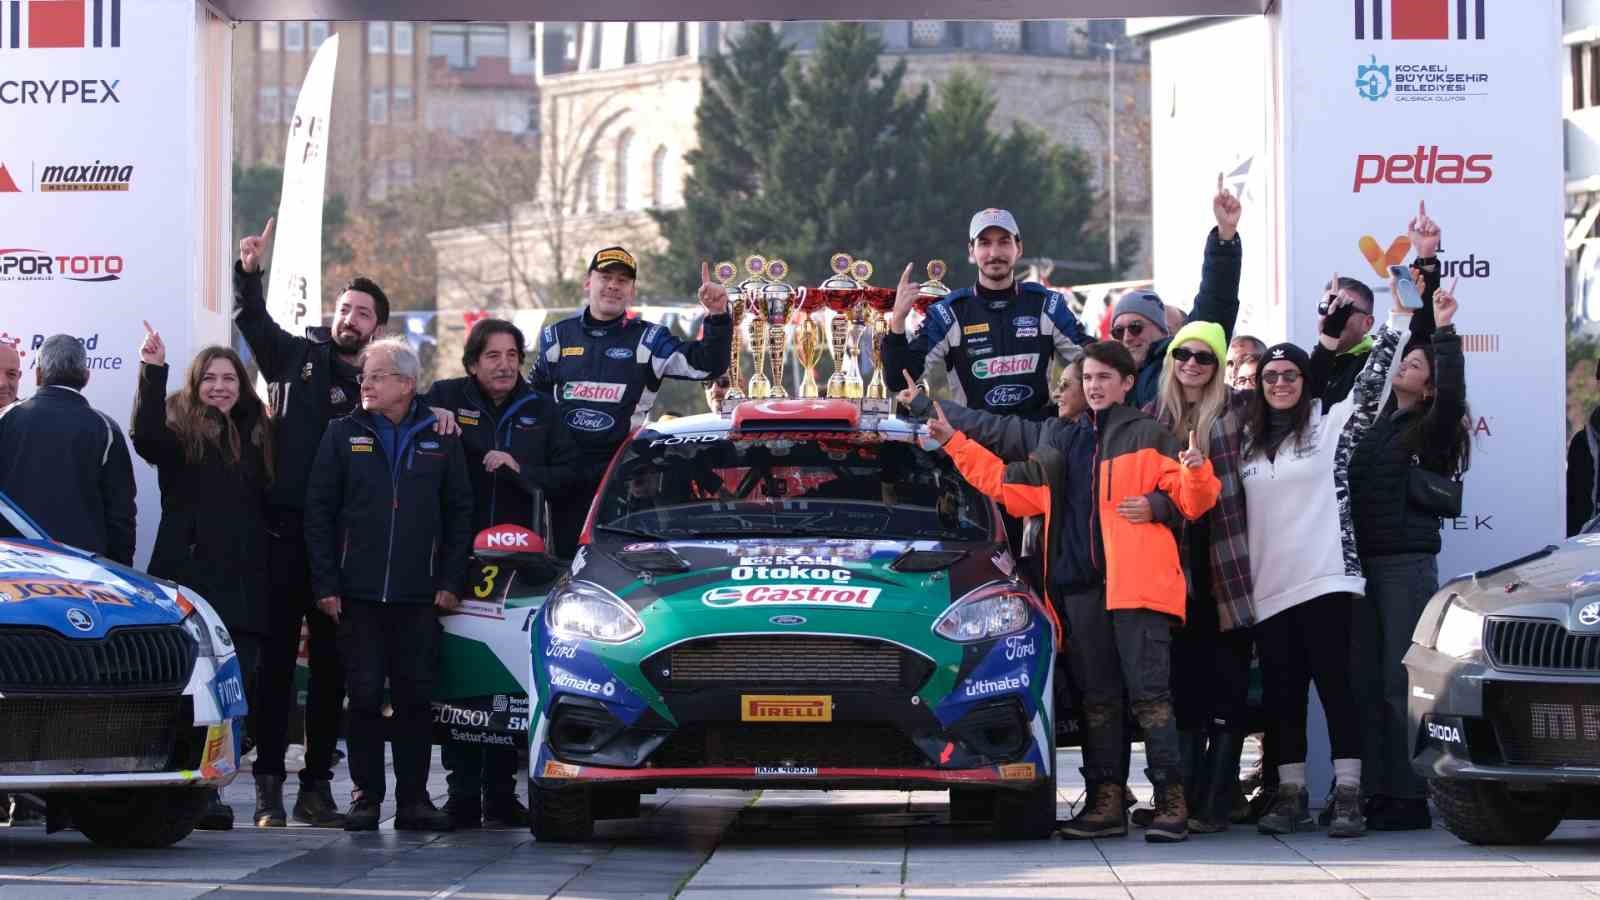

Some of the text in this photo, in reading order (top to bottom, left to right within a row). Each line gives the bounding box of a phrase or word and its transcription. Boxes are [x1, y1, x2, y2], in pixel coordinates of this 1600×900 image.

[0, 79, 120, 103] CRYPEX
[41, 160, 134, 183] maxima
[1352, 145, 1493, 193] petlas
[1440, 254, 1490, 278] urda
[990, 356, 1034, 375] Castrol
[573, 383, 620, 400] Castrol
[992, 386, 1022, 404] Ford
[572, 410, 604, 428] Ford
[649, 434, 719, 448] FORD
[487, 533, 529, 547] NGK
[474, 565, 499, 598] 3
[731, 565, 851, 584] Otokoç
[745, 586, 868, 605] Castrol
[546, 637, 580, 659] Ford
[1005, 635, 1035, 660] Ford
[965, 676, 1021, 696] ultimate
[749, 701, 825, 717] PIRELLI
